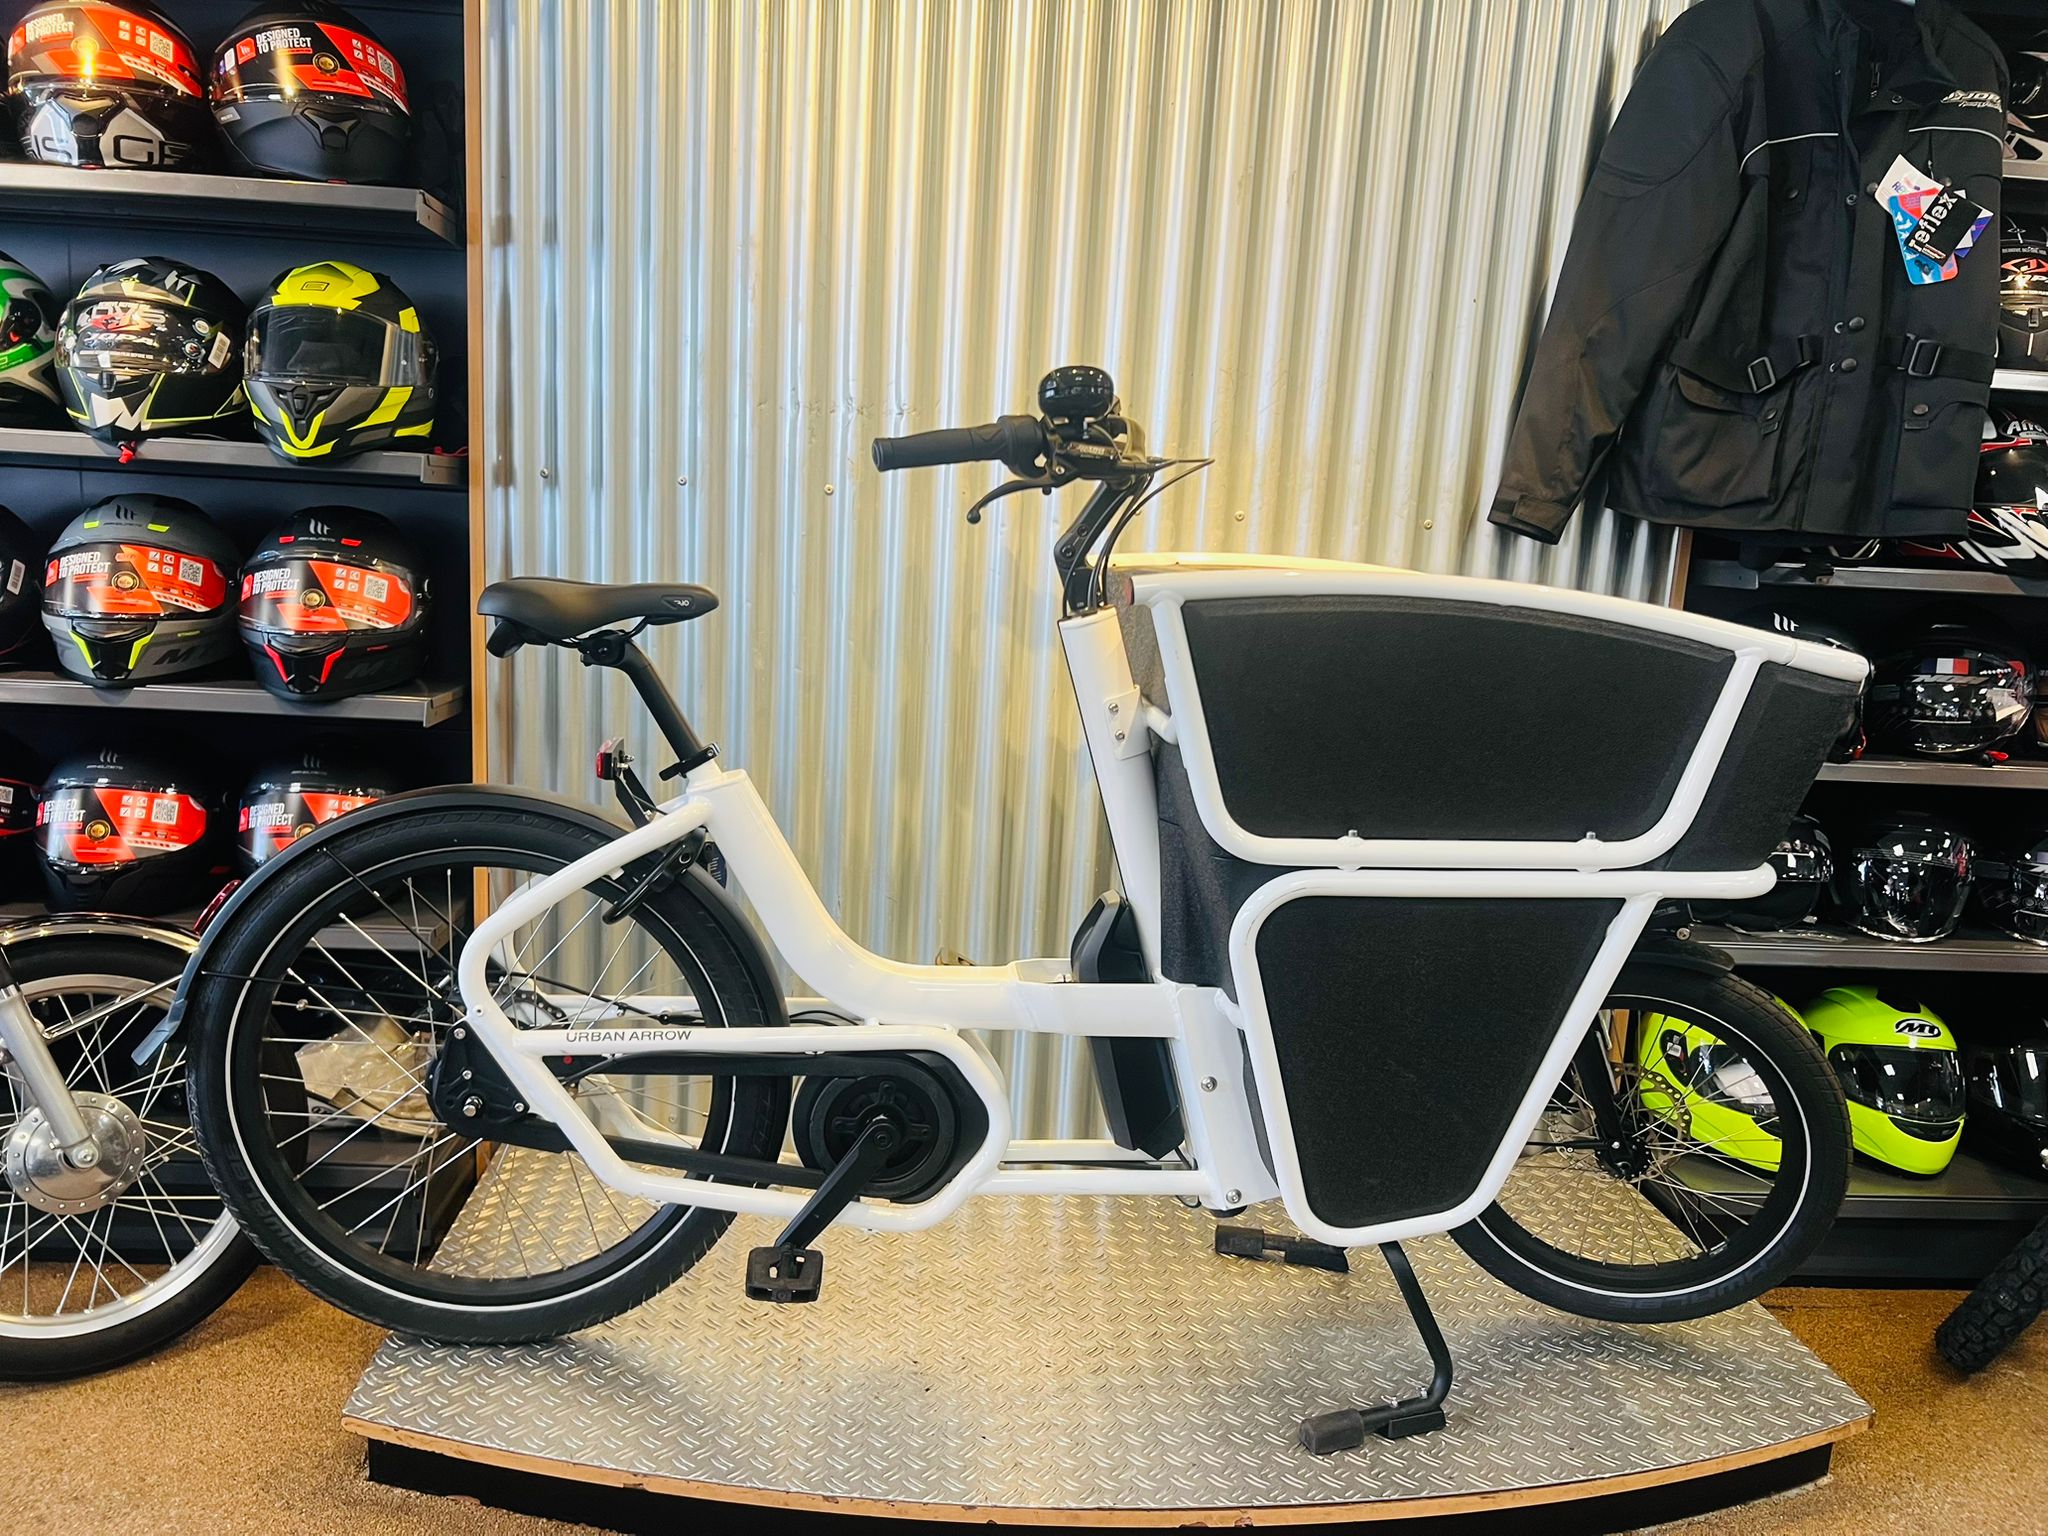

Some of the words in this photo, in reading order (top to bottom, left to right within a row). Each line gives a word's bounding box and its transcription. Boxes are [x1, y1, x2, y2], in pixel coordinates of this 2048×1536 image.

[36, 21, 74, 40] PROTECT
[256, 27, 300, 44] DESIGNED
[257, 42, 270, 54] TO
[271, 37, 312, 53] PROTECT
[1908, 192, 1959, 252] reflex
[60, 551, 101, 567] DESIGNED
[59, 565, 68, 579] TO
[68, 562, 111, 577] PROTECT
[254, 568, 290, 582] DESIGNED
[253, 581, 260, 595] TO
[260, 579, 299, 594] PROTECT
[250, 803, 285, 816] DESIGNED
[256, 814, 294, 828] PROTECT
[566, 1031, 625, 1042] URBAN
[629, 1030, 692, 1041] ARROW
